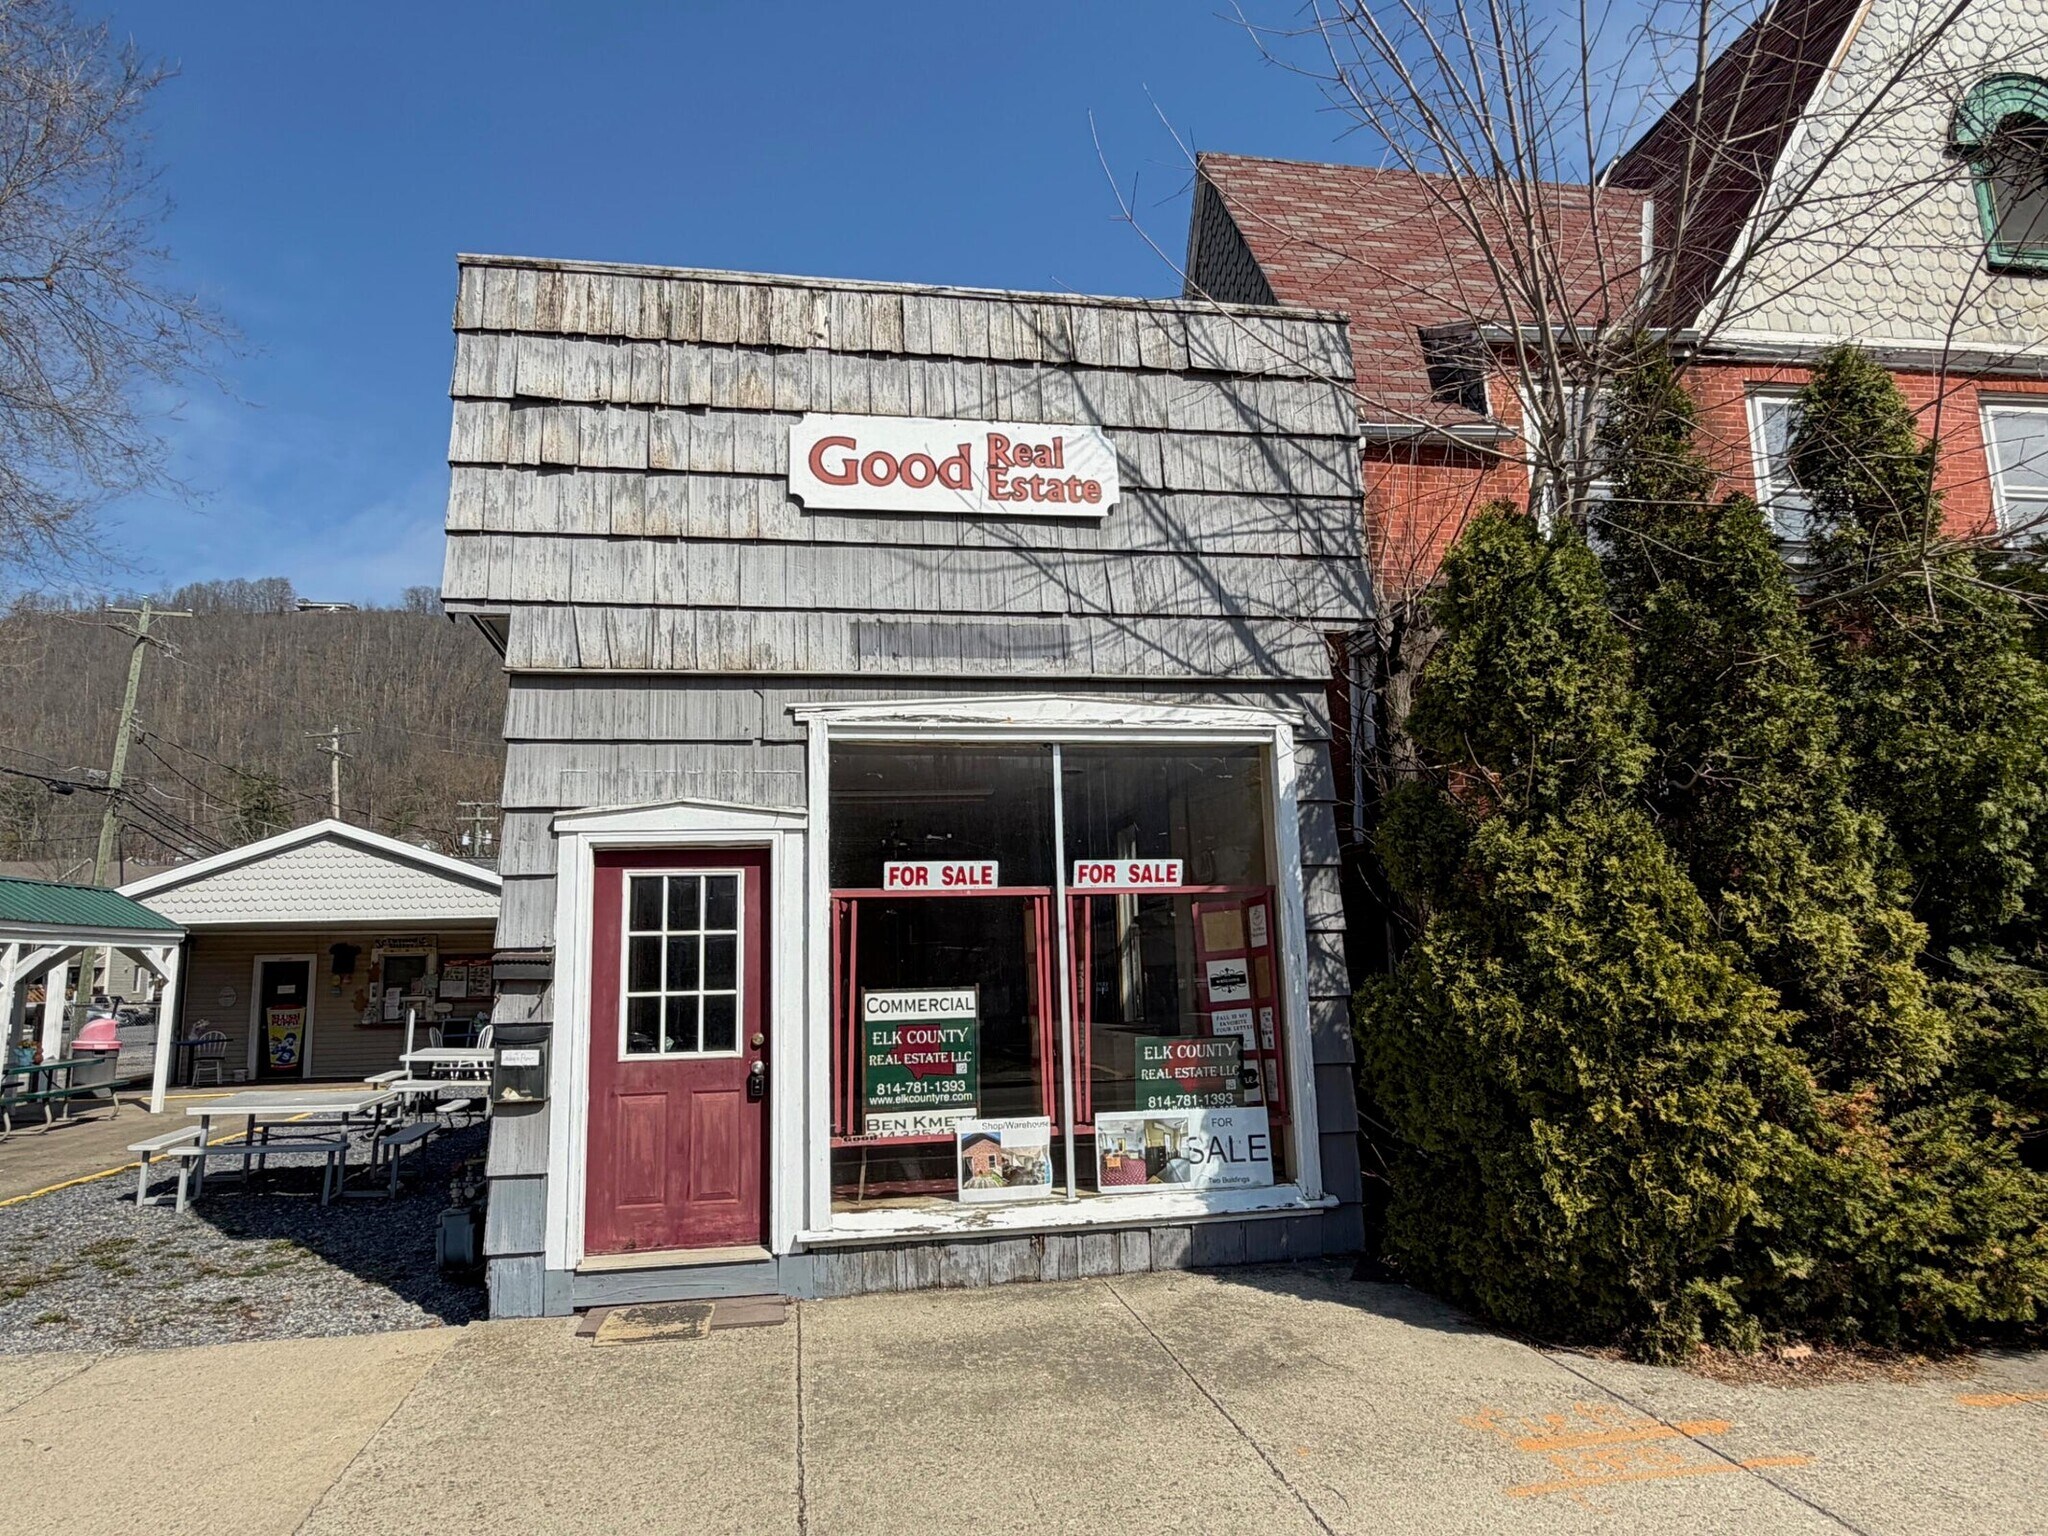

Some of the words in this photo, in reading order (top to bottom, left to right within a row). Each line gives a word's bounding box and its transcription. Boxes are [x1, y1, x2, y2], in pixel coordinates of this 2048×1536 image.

[808, 435, 973, 490] Good
[986, 432, 1064, 469] Real
[988, 467, 1103, 504] Estate
[888, 866, 928, 886] FOR
[941, 865, 992, 885] SALE
[1077, 864, 1116, 883] FOR
[1128, 863, 1178, 883] SALE
[866, 997, 975, 1014] COMMERCIAL
[872, 1030, 903, 1046] ELK
[906, 1026, 969, 1044] COUNTY
[868, 1054, 902, 1067] REAL
[903, 1051, 949, 1065] ESTATE
[951, 1050, 973, 1063] LLC
[1144, 1045, 1173, 1060] ELK
[1177, 1040, 1236, 1059] COUNTY
[1141, 1068, 1173, 1081] REAL
[1174, 1065, 1218, 1079] ESTATE
[1219, 1064, 1241, 1077] LLC
[876, 1080, 966, 1095] 814-781-1393
[869, 1091, 973, 1105] www.elkcountyre.com
[1147, 1092, 1234, 1109] 814-781-1393
[866, 1118, 907, 1132] BEN
[981, 1120, 1049, 1131] Shop/Warehouse
[1211, 1117, 1234, 1128] FOR
[1188, 1133, 1270, 1165] SALE
